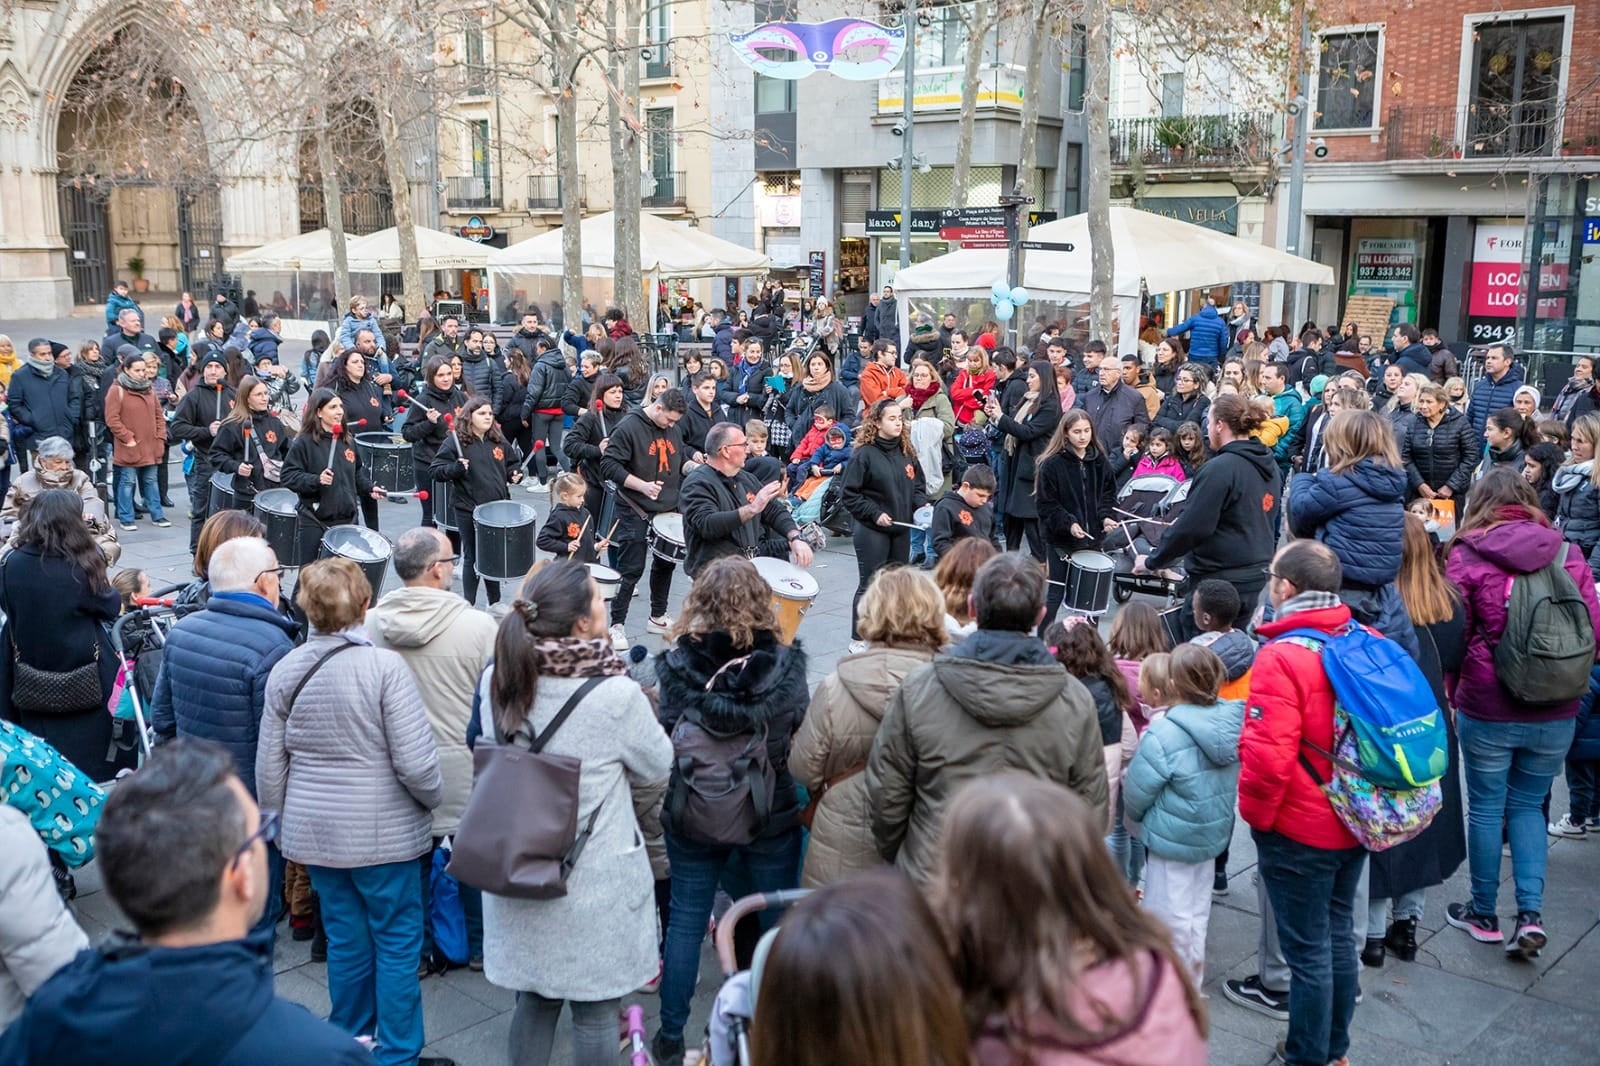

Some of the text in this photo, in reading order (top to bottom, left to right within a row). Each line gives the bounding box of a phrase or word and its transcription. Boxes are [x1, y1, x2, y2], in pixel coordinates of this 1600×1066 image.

[1188, 207, 1227, 221] VELLA
[869, 218, 936, 230] Marco dany
[1360, 255, 1412, 265] EN LLOGUER
[1360, 266, 1411, 276] 937 333 342
[1487, 272, 1561, 287] LOCA EN
[1487, 292, 1558, 307] LLOGER
[1473, 324, 1503, 339] 934
